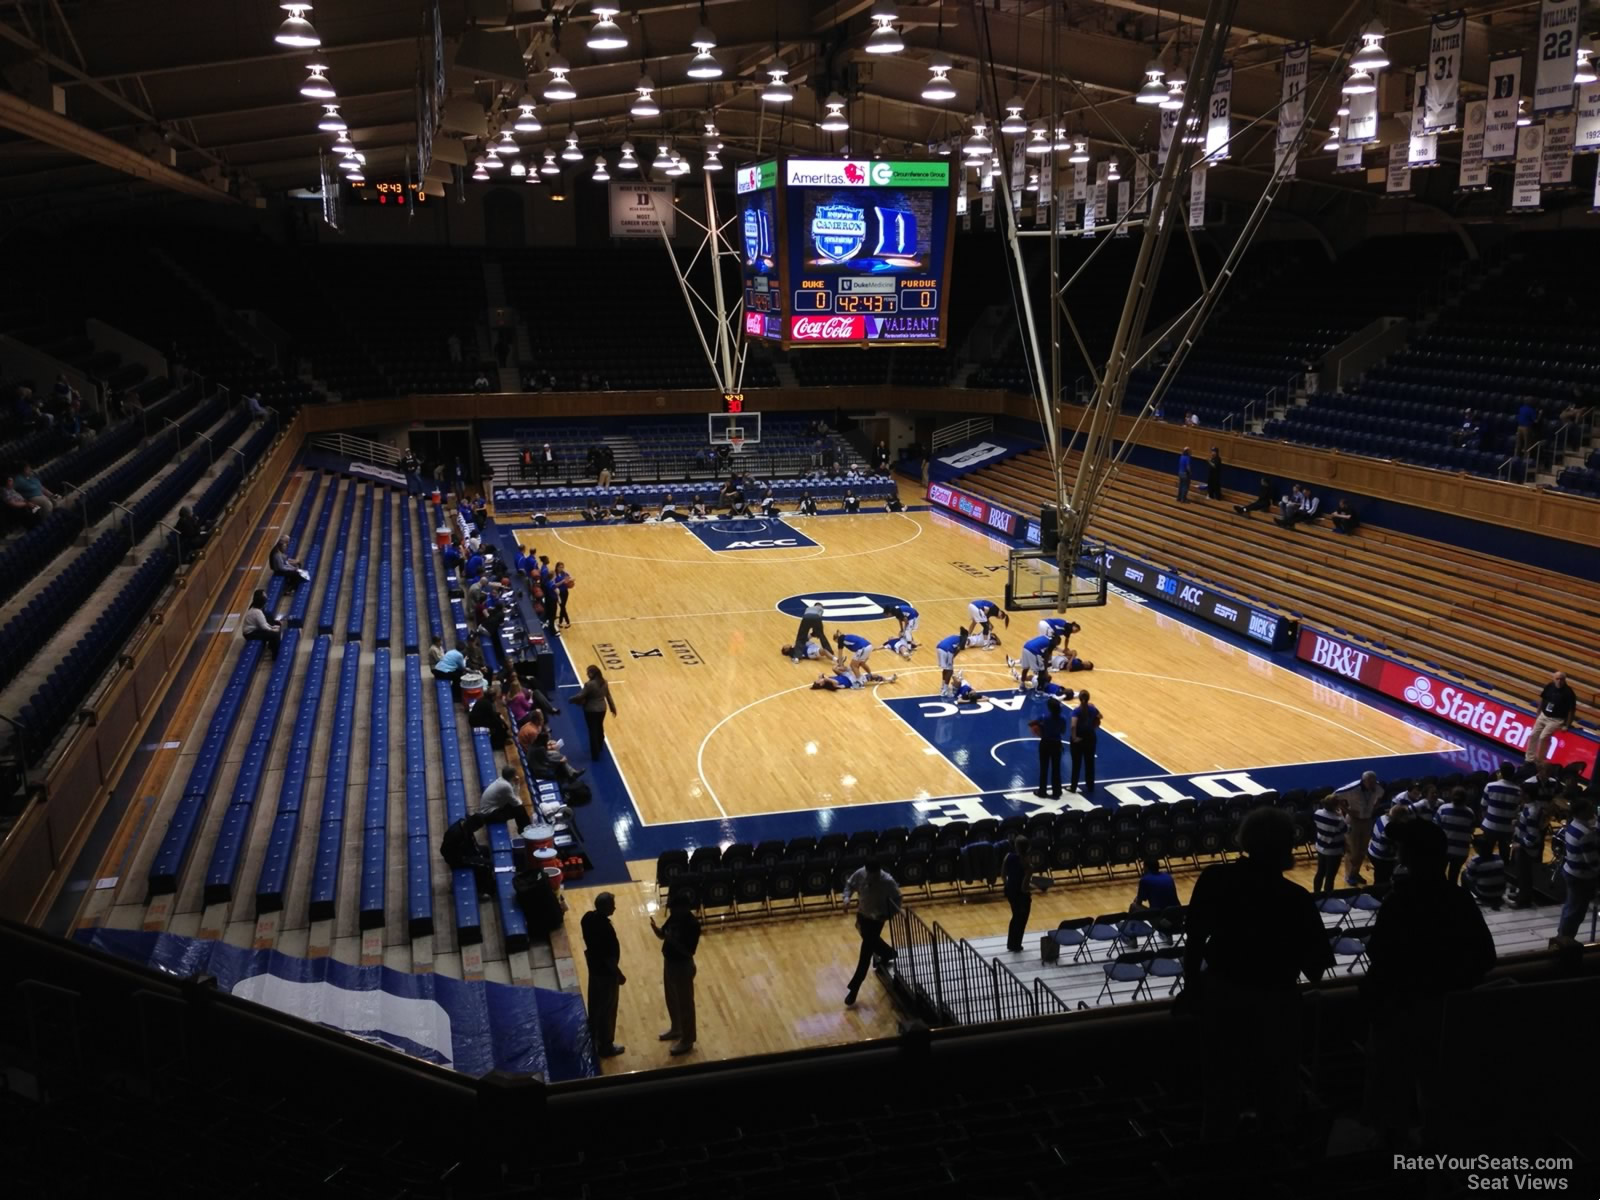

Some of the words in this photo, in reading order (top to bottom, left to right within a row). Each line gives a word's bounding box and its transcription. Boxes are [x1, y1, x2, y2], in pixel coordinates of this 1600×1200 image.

[1543, 6, 1577, 28] WILLIAMS
[1432, 34, 1460, 53] BATTIER
[1543, 30, 1573, 60] 22
[1434, 56, 1454, 81] 31
[1212, 98, 1228, 119] 32
[1494, 109, 1508, 119] NCAA
[1486, 123, 1500, 134] FINAL
[1500, 120, 1515, 131] FOUR
[377, 183, 402, 193] 42:43
[816, 220, 862, 231] CAMERON
[802, 280, 825, 289] DUKE
[901, 280, 937, 288] PURDUE
[816, 292, 826, 309] 0
[839, 296, 883, 312] 42:43
[920, 291, 931, 308] 0
[793, 316, 856, 339] Coca-Cola
[884, 318, 937, 331] VALEANT
[728, 400, 742, 413] 30
[988, 507, 1012, 533] BB&T
[725, 539, 798, 549] ACC
[1125, 567, 1145, 583] ESPN
[1179, 585, 1204, 606] ACC
[1213, 603, 1238, 622] ESPN
[1311, 635, 1370, 681] BB&T
[917, 694, 1027, 718] ACC
[913, 772, 1277, 826] DUKE
